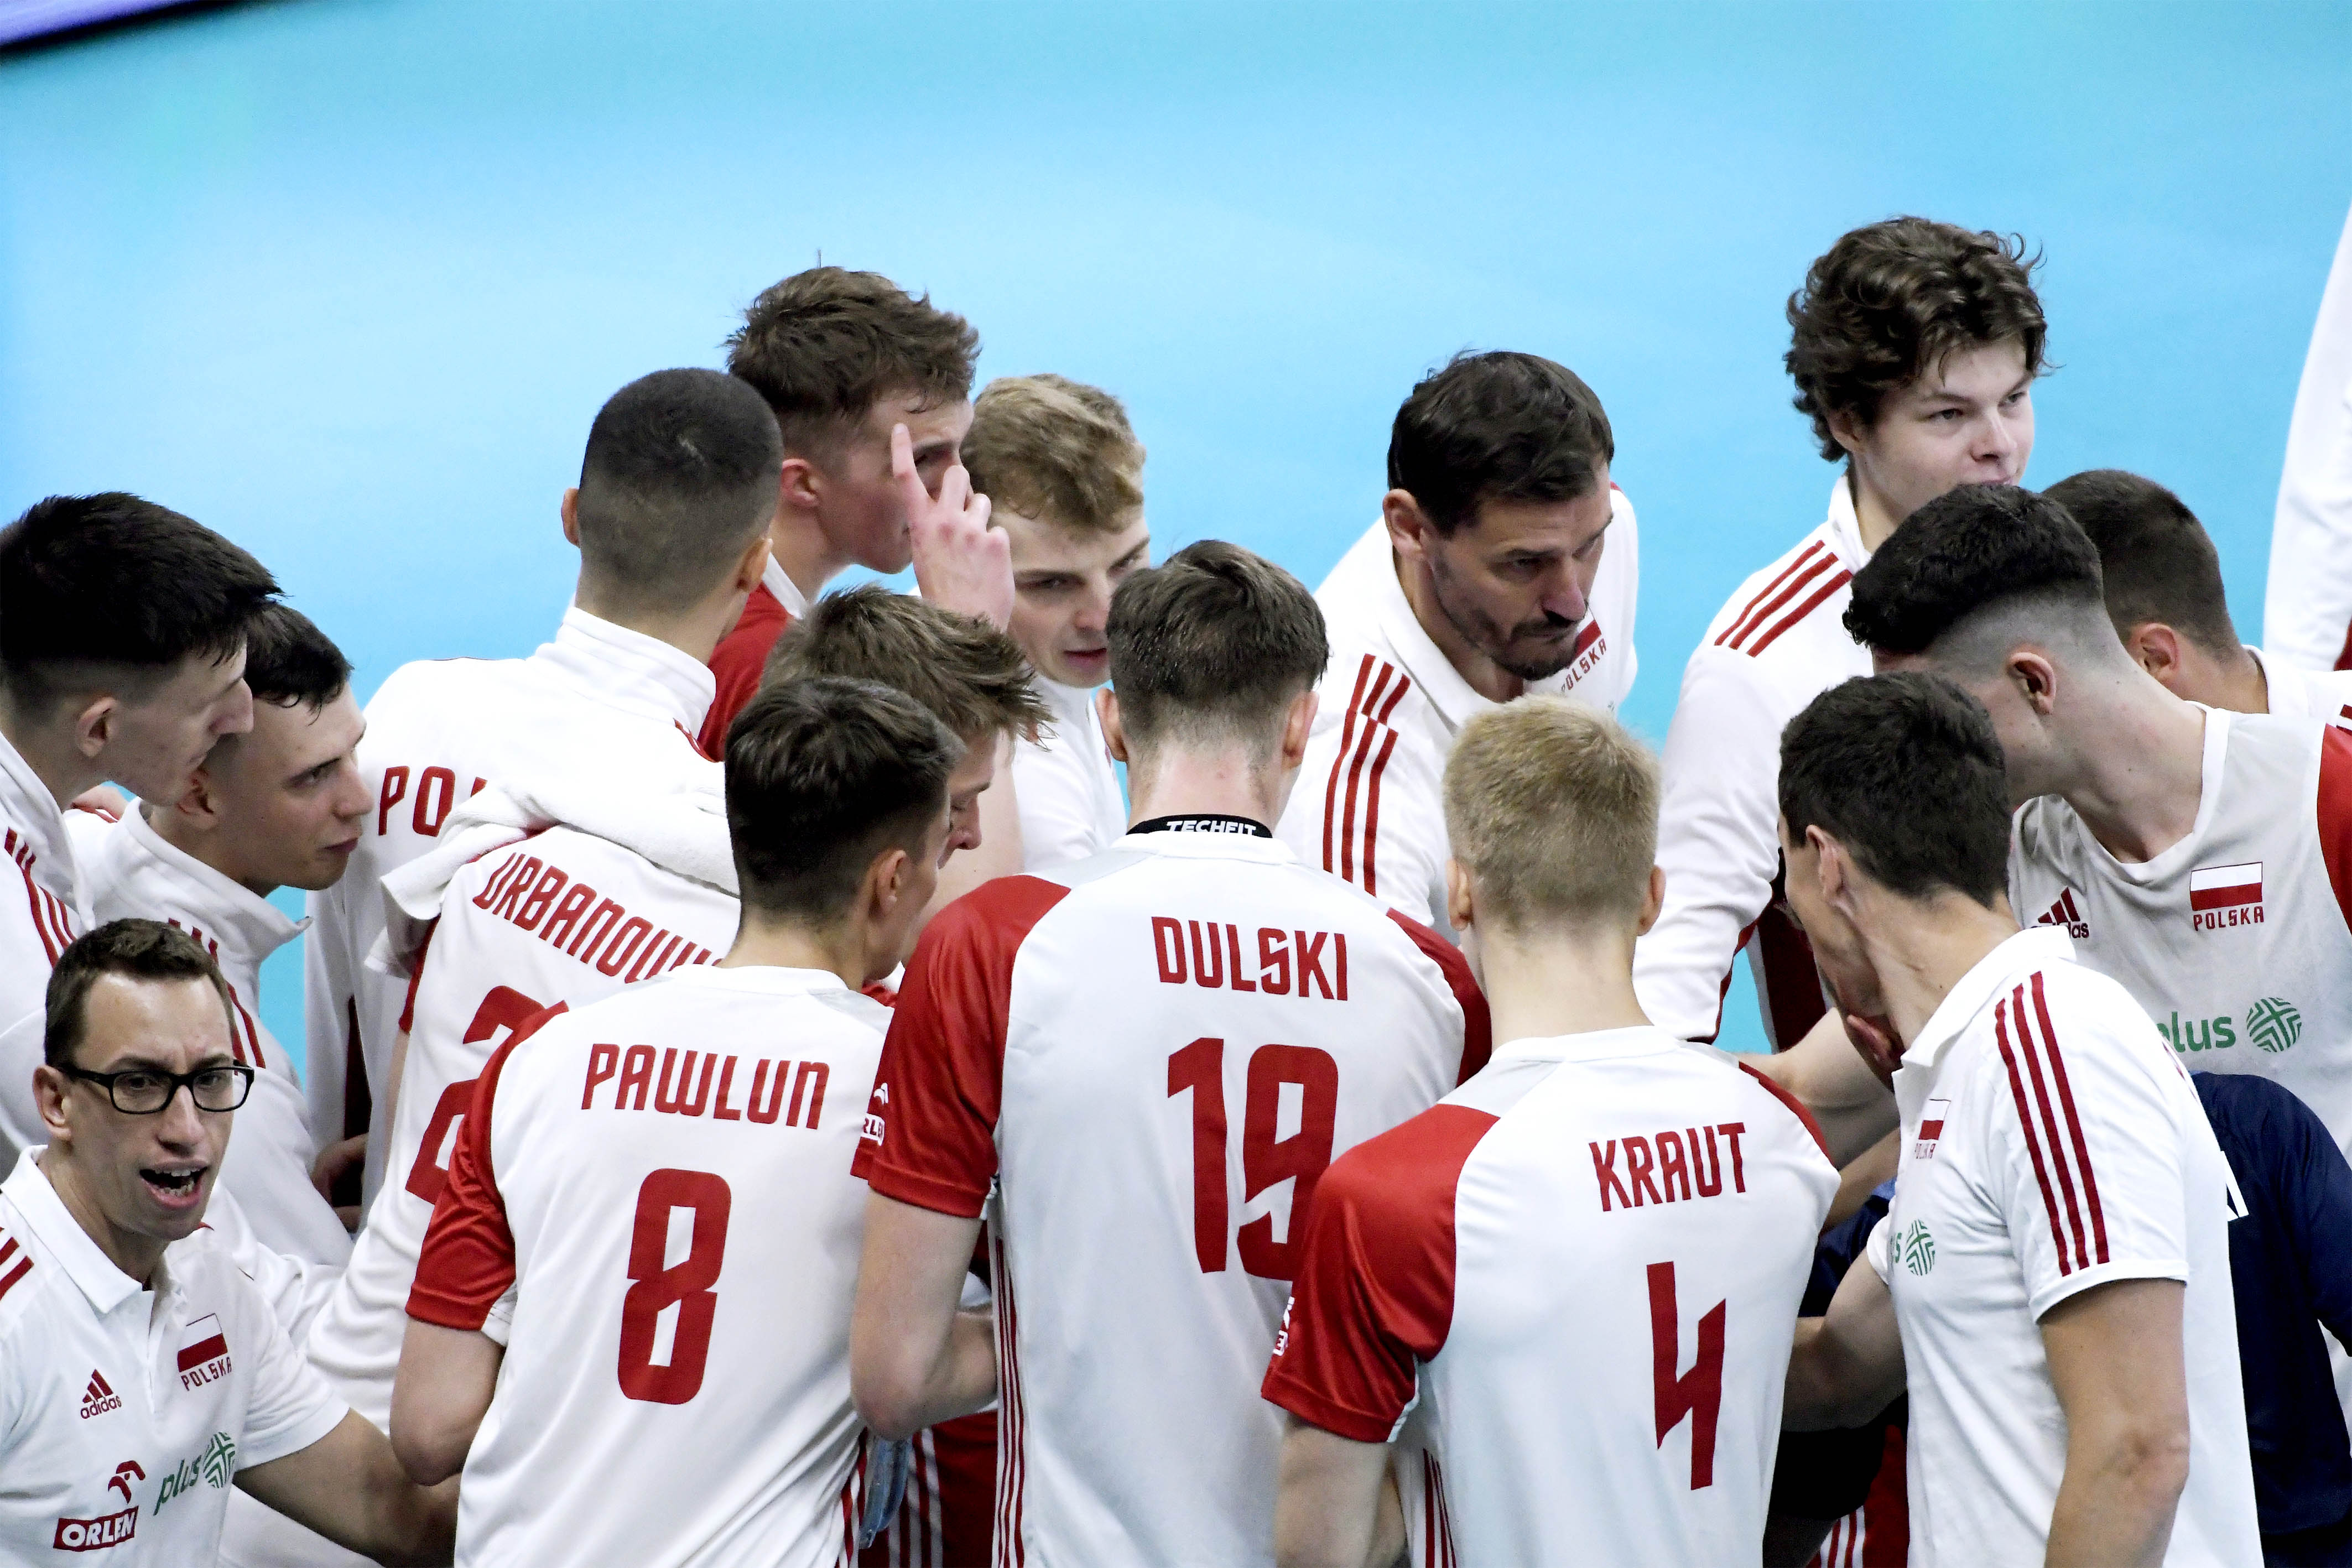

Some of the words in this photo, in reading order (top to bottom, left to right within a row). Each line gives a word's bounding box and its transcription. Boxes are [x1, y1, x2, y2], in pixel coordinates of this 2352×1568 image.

[378, 765, 487, 837] PO
[1167, 820, 1256, 836] TECHFIT
[472, 851, 723, 983] URBANOW
[2193, 906, 2264, 931] POLSKA
[1152, 916, 1348, 1001] DULSKI
[582, 1043, 830, 1130] PAWLUN
[1168, 1038, 1339, 1280] 19
[1589, 1122, 1746, 1212] KRAUT
[617, 1168, 731, 1405] 8
[80, 1395, 122, 1419] adidas
[181, 1356, 232, 1391] POLSKA
[1647, 1262, 1726, 1490] 4
[153, 1454, 202, 1517] plus
[61, 1510, 137, 1548] ORLEN
